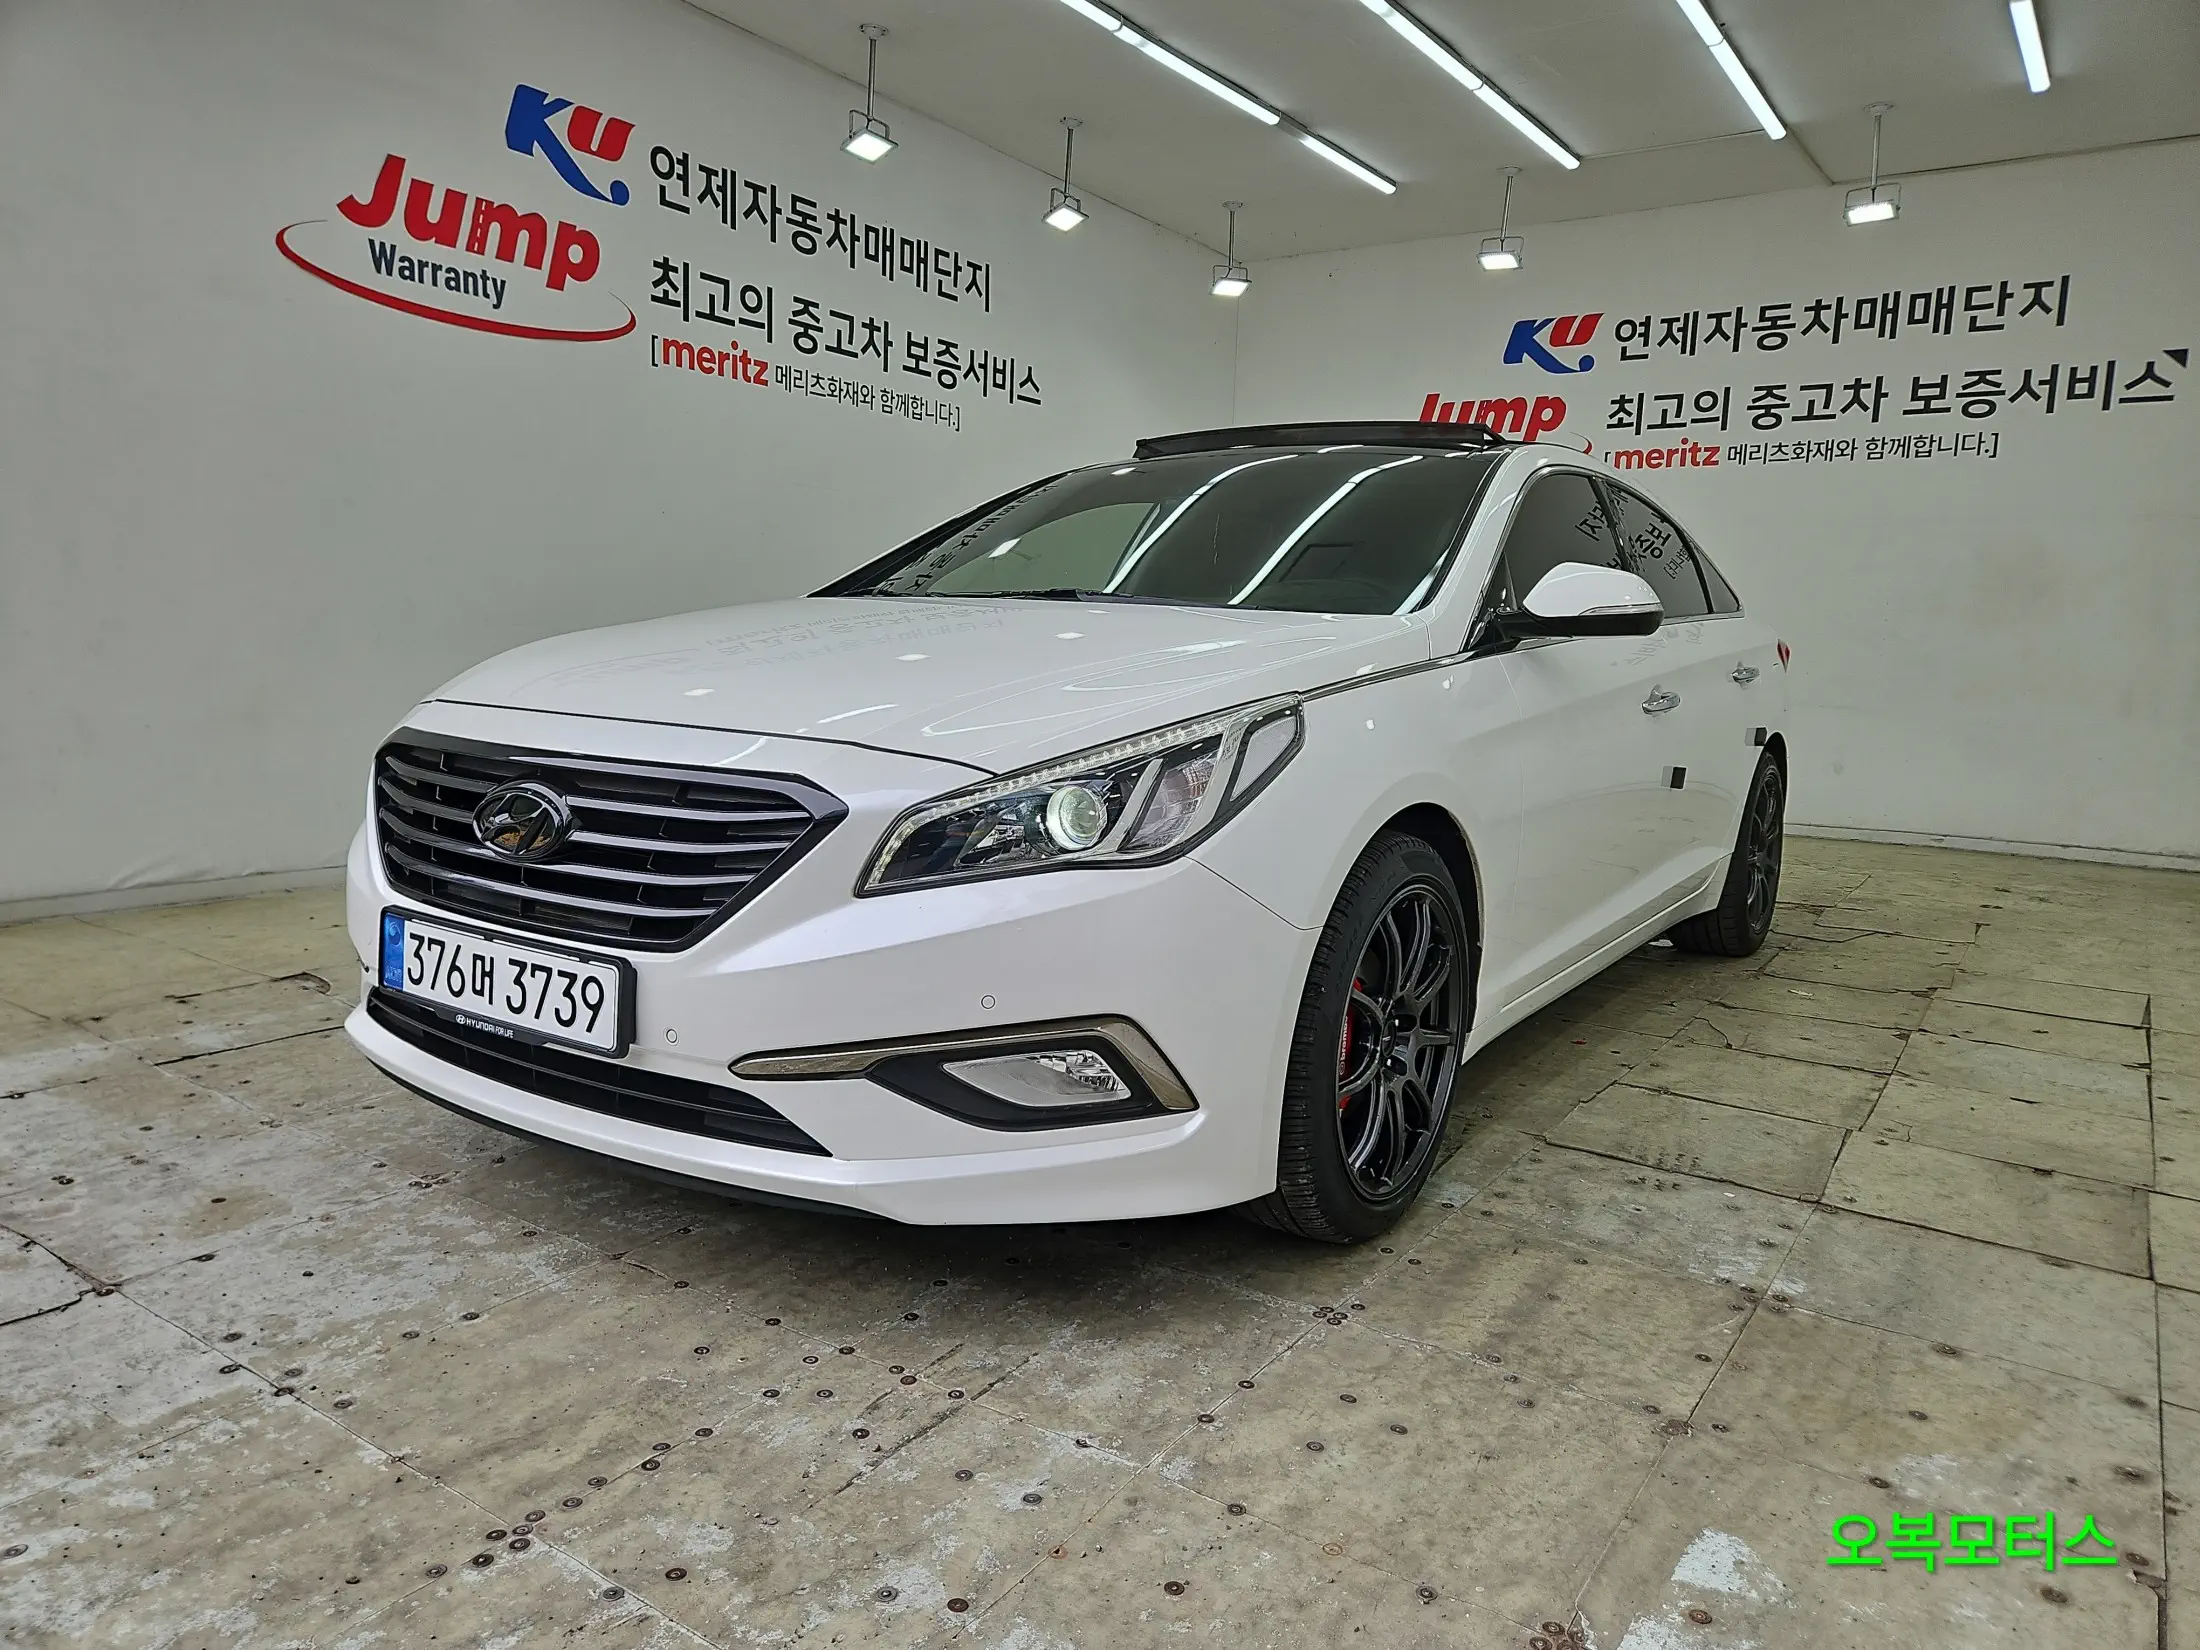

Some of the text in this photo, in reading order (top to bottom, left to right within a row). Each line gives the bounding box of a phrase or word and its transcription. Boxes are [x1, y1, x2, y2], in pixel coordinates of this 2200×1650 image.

[337, 153, 600, 292] Jump
[649, 144, 991, 312] 연제자동차매매단지
[368, 238, 506, 310] Warranty
[650, 256, 1042, 405] 최고의 중고차 보증서비스
[1614, 275, 2071, 361] 연제자동차매매단지
[775, 364, 876, 411] 메리츠화재와
[880, 388, 960, 432] 함께합니다.]
[1605, 360, 2175, 435] 최고의 중고차 보증서비스
[1727, 438, 1858, 466] 메리츠화재와
[1865, 432, 2000, 461] 함께합니다.]
[505, 958, 605, 1034] 3739
